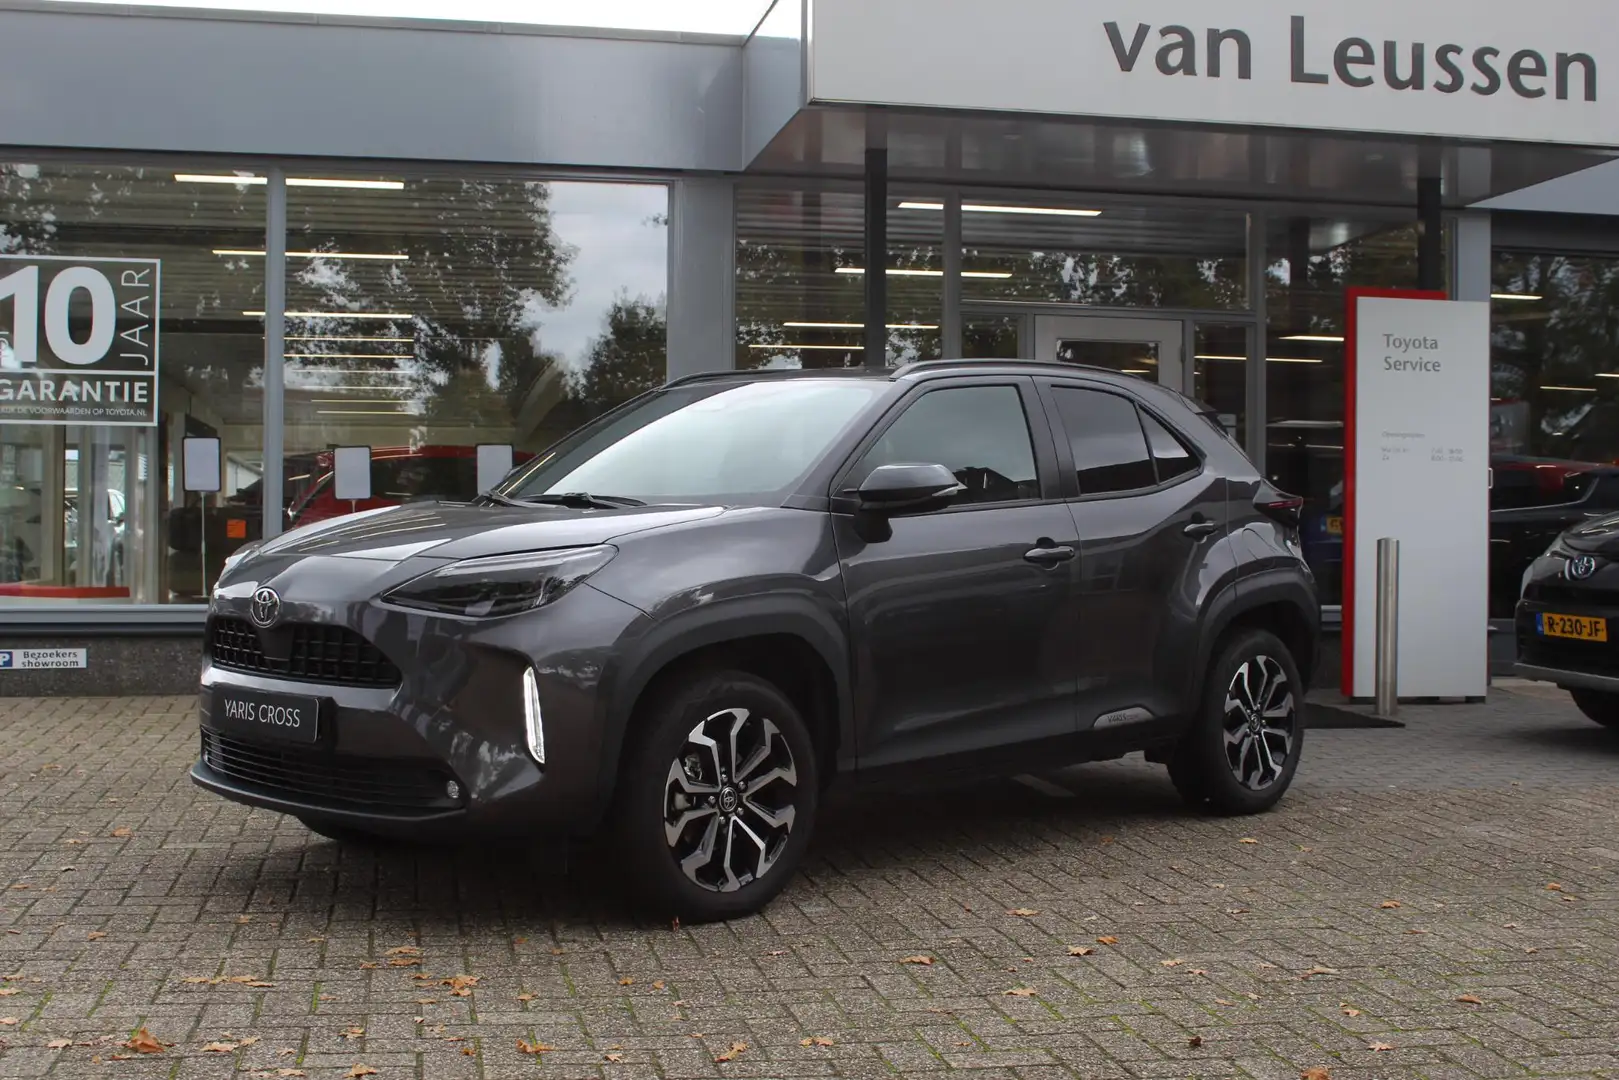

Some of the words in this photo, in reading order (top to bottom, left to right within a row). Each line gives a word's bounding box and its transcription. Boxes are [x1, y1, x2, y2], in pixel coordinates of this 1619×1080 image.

[1103, 21, 1252, 80] van
[1290, 15, 1597, 102] Leussen
[0, 265, 116, 365] 10
[120, 268, 150, 366] JAAR
[1382, 333, 1439, 353] Toyota
[1383, 356, 1441, 372] Service
[0, 379, 148, 403] GARANTIE
[30, 406, 91, 415] VOORWAARDEN
[92, 407, 104, 416] OP
[105, 407, 147, 417] TOYOTA.NL
[1547, 616, 1601, 637] R-230-JF
[21, 660, 79, 668] showroom
[23, 650, 78, 659] Bezoekers
[224, 699, 255, 721] YARIS
[258, 704, 301, 728] CROSS
